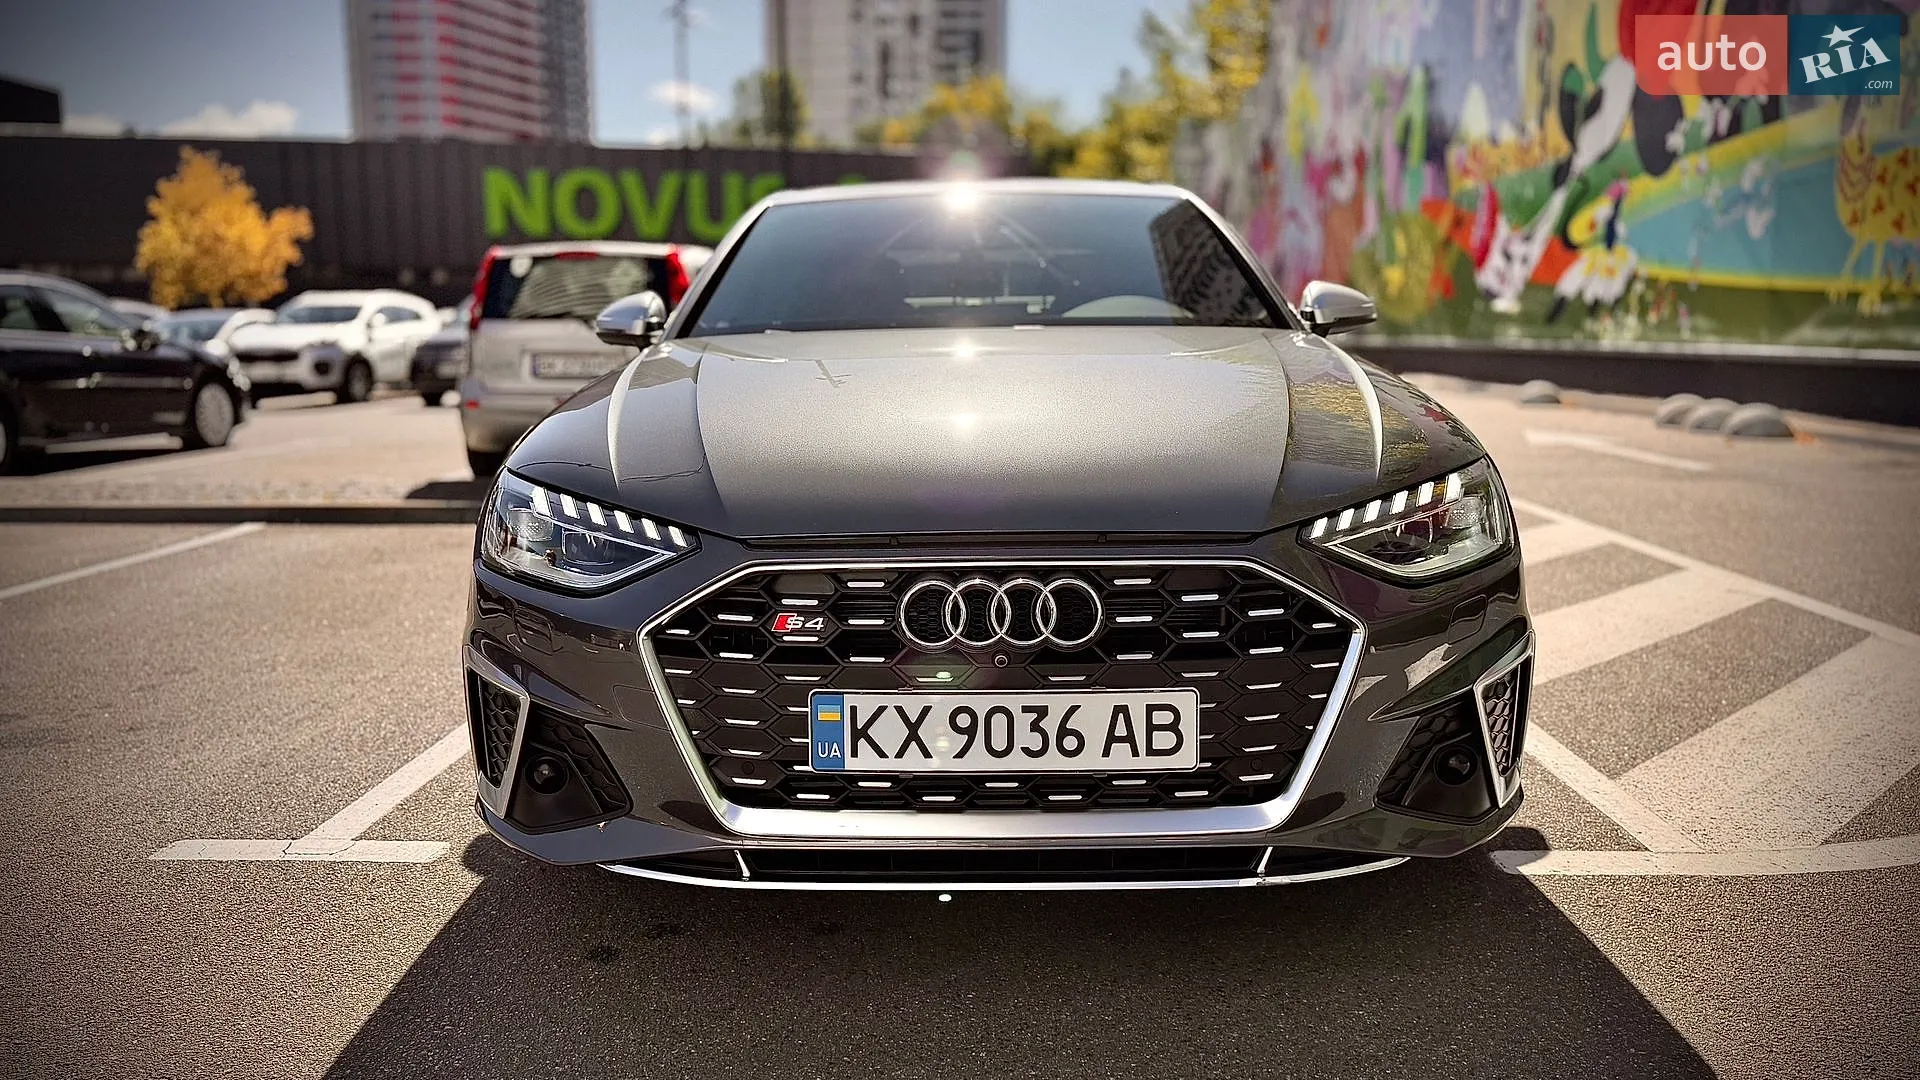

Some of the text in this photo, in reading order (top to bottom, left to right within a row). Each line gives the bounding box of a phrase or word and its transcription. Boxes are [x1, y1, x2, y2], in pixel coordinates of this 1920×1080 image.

[785, 616, 824, 630] S4
[849, 703, 1184, 759] KX 9036 AB
[817, 740, 842, 758] UA
